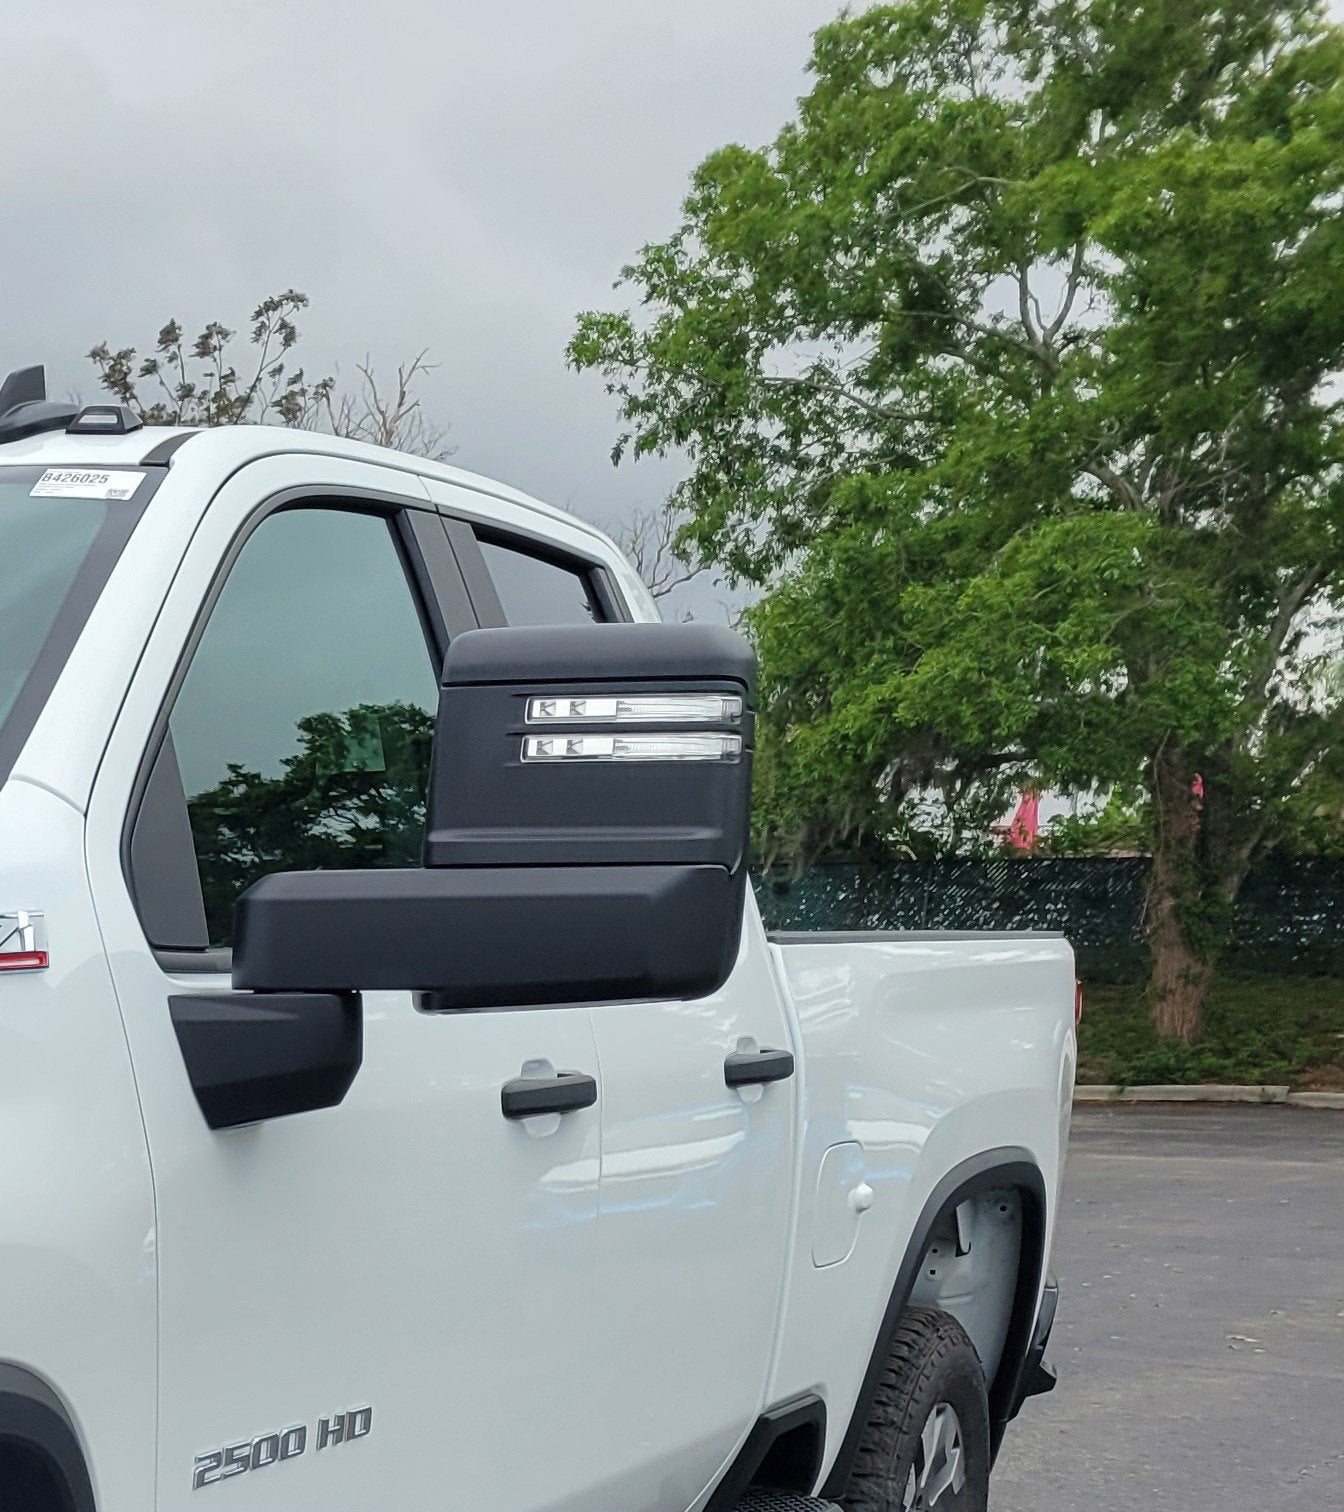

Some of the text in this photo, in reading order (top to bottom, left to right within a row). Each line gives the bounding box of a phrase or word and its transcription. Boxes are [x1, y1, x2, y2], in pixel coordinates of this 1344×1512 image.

[40, 472, 111, 485] B426025
[192, 1405, 373, 1491] 2500 HD
